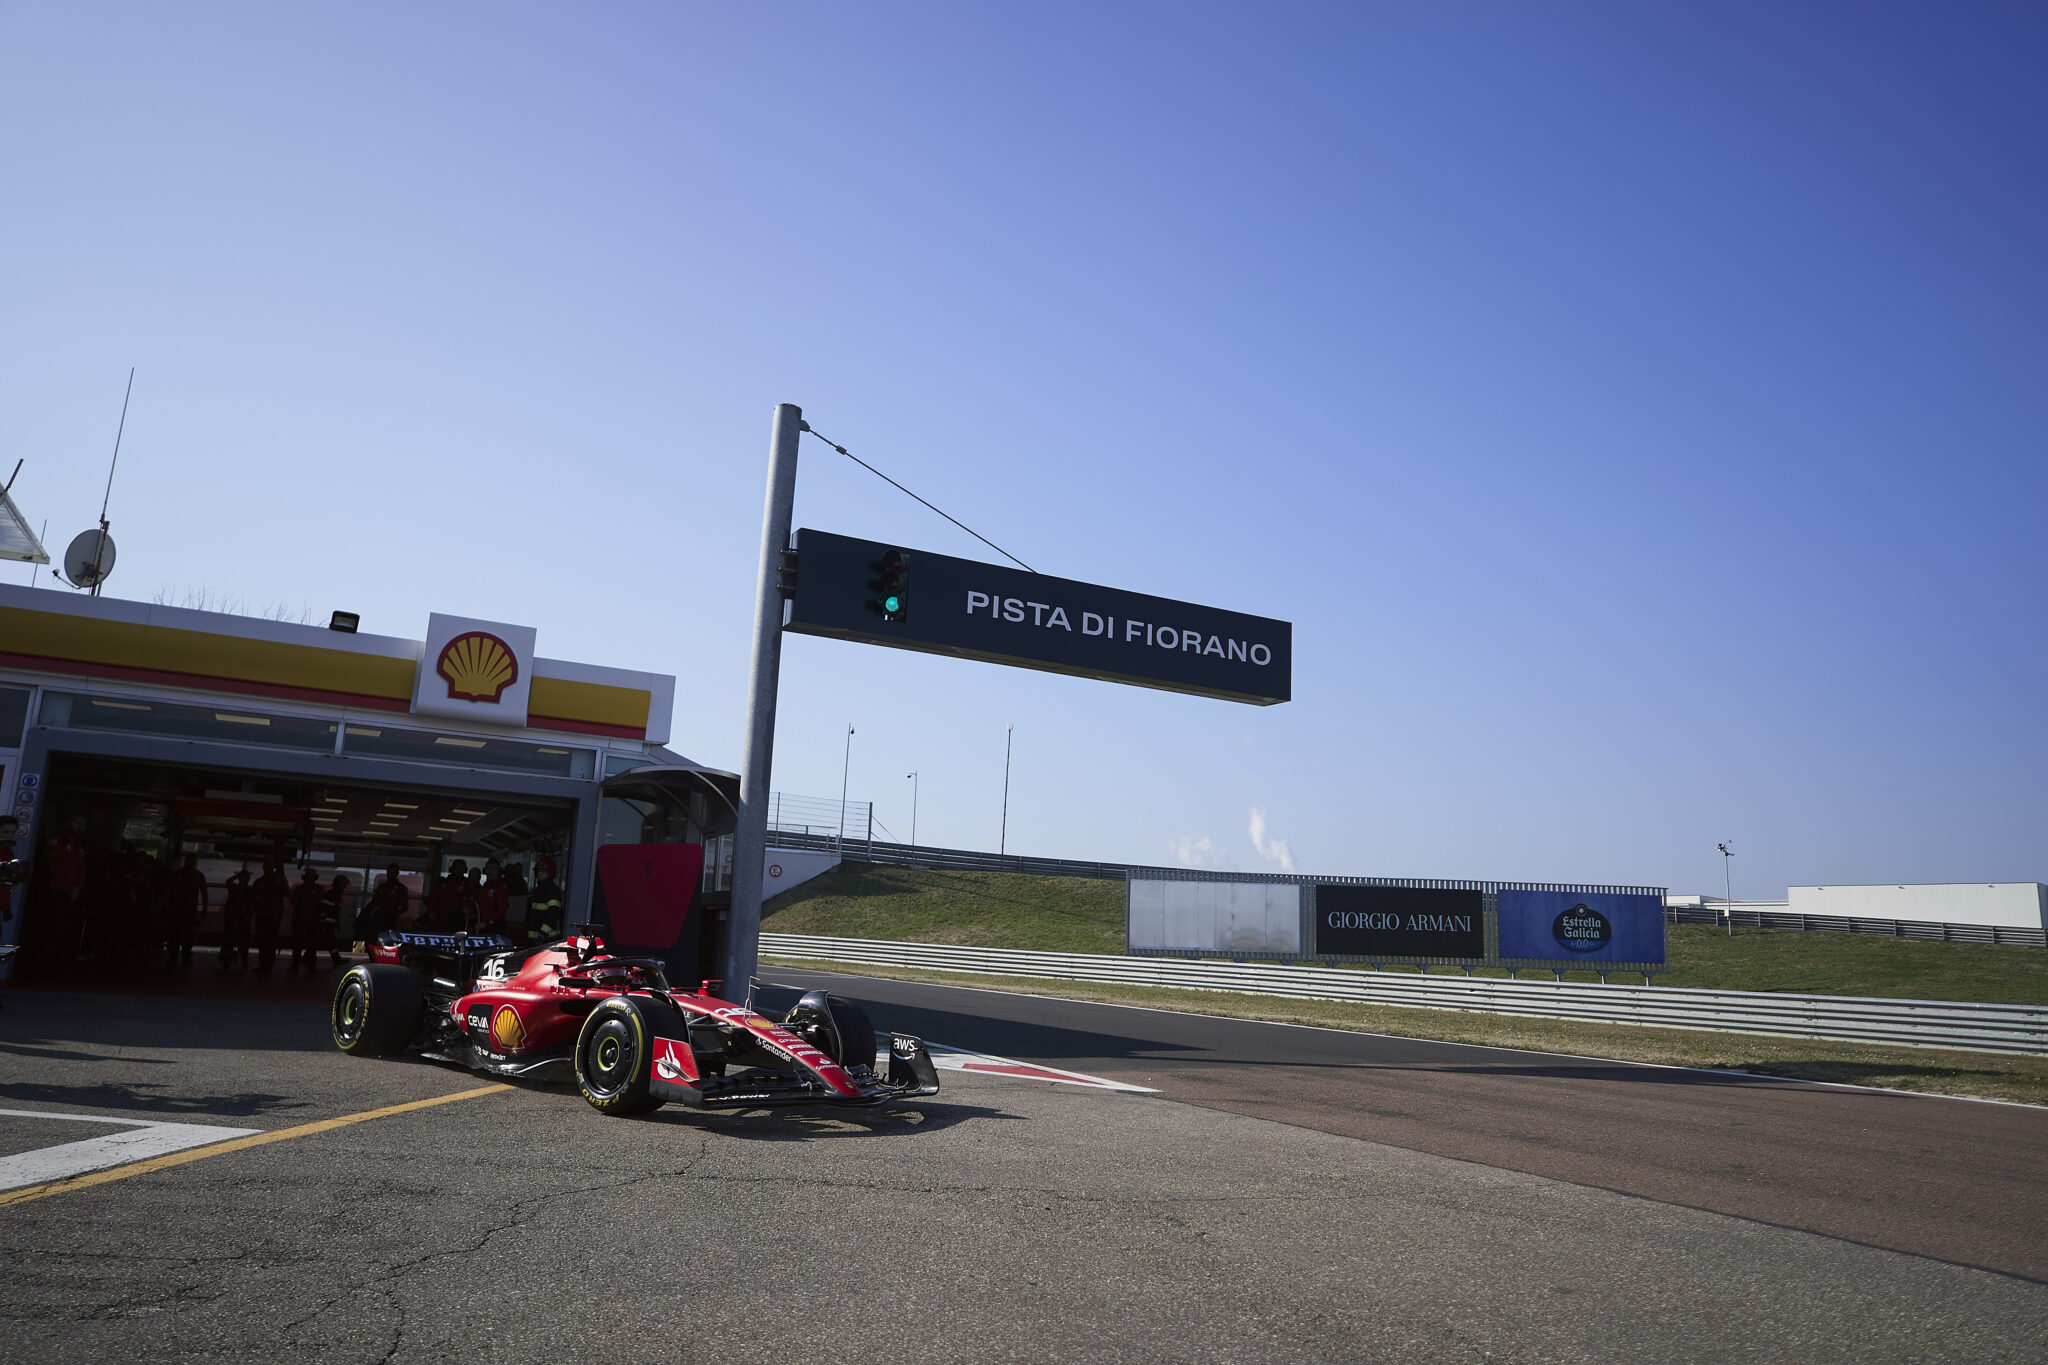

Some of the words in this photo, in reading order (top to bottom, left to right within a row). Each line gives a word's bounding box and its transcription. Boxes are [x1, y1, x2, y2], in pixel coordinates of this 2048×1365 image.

[966, 590, 1072, 632] PISTA
[1082, 611, 1114, 639] DI
[1126, 619, 1272, 666] FIORANO
[1328, 911, 1400, 930] GIORGIO
[1405, 914, 1471, 932] ARMANI
[1562, 916, 1601, 928] Estrella
[1563, 927, 1600, 938] Galicia
[481, 958, 505, 980] 16
[761, 1040, 792, 1063] Santander
[893, 1038, 915, 1051] aws
